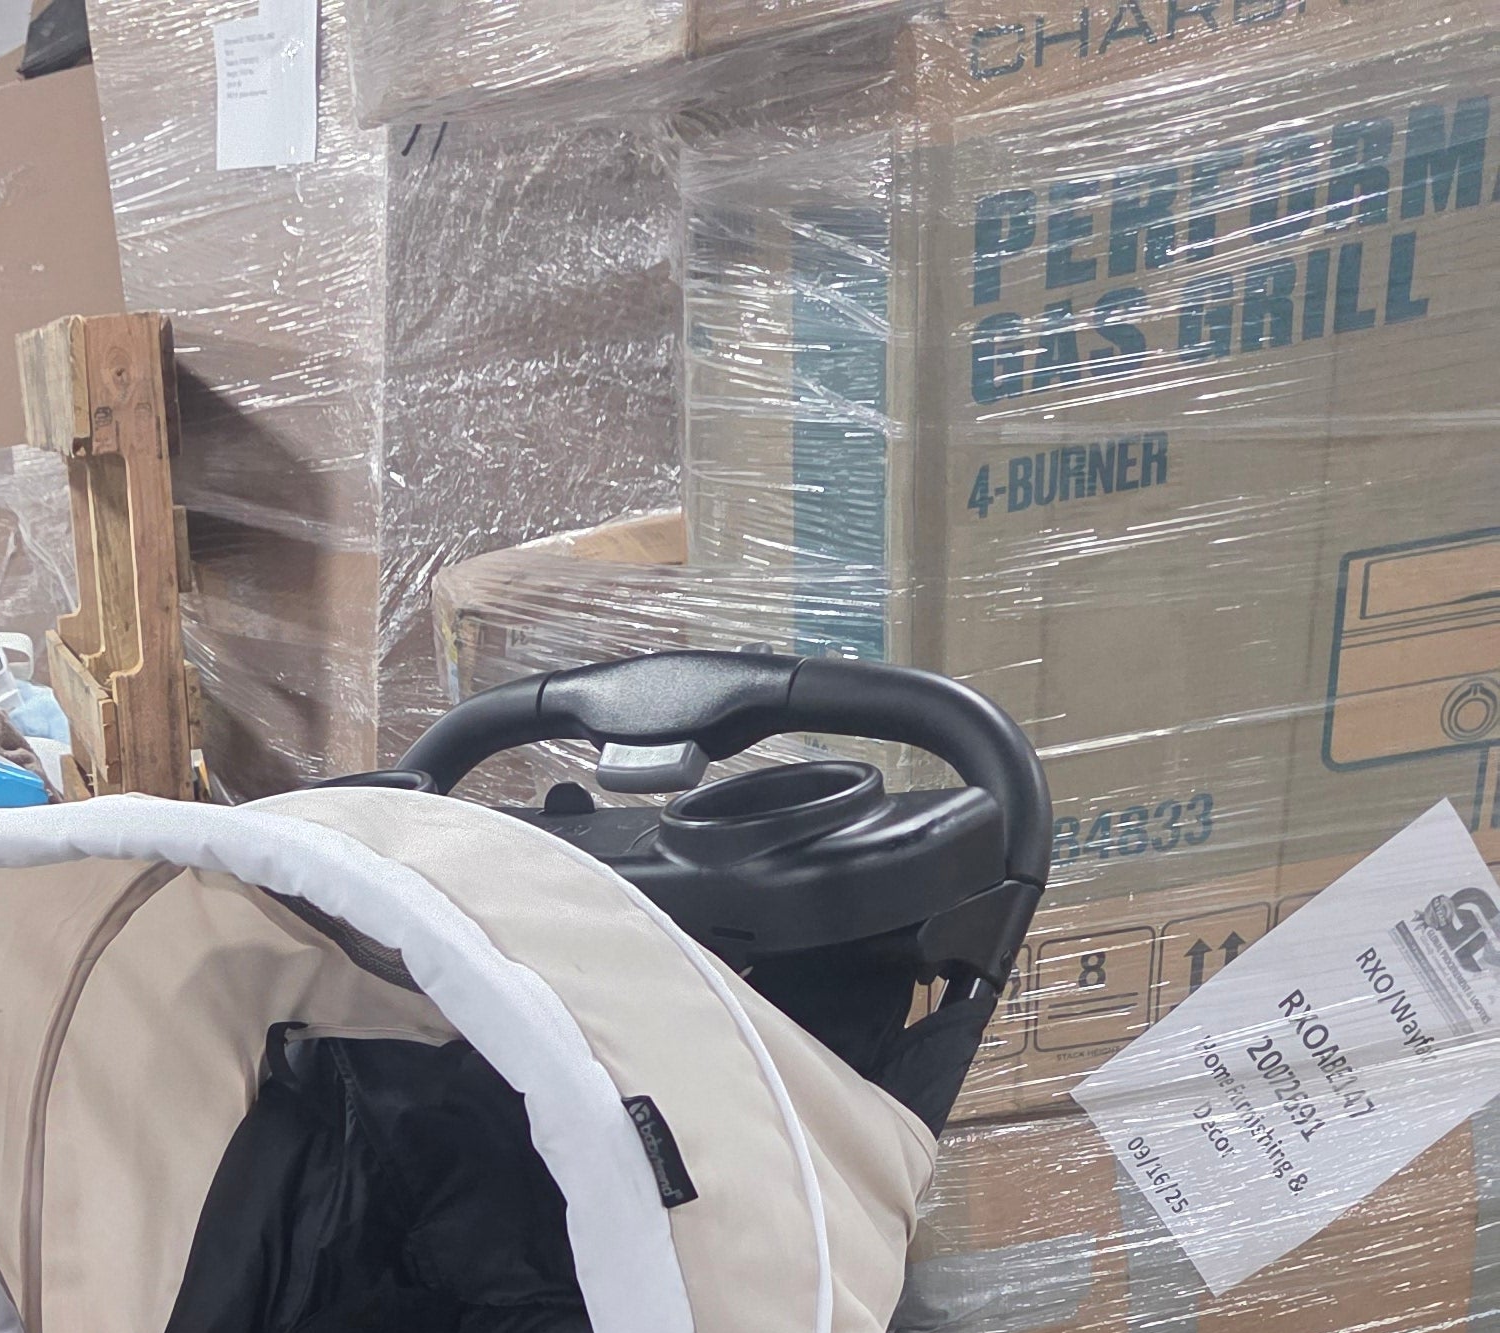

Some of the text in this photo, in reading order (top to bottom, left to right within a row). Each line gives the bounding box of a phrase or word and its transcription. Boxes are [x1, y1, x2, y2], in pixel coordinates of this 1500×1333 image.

[974, 95, 1500, 307] PERFORM
[971, 231, 1430, 405] GAS GRILL
[967, 431, 1169, 519] 4-BURNER
[1126, 1135, 1190, 1216] 09/16/25
